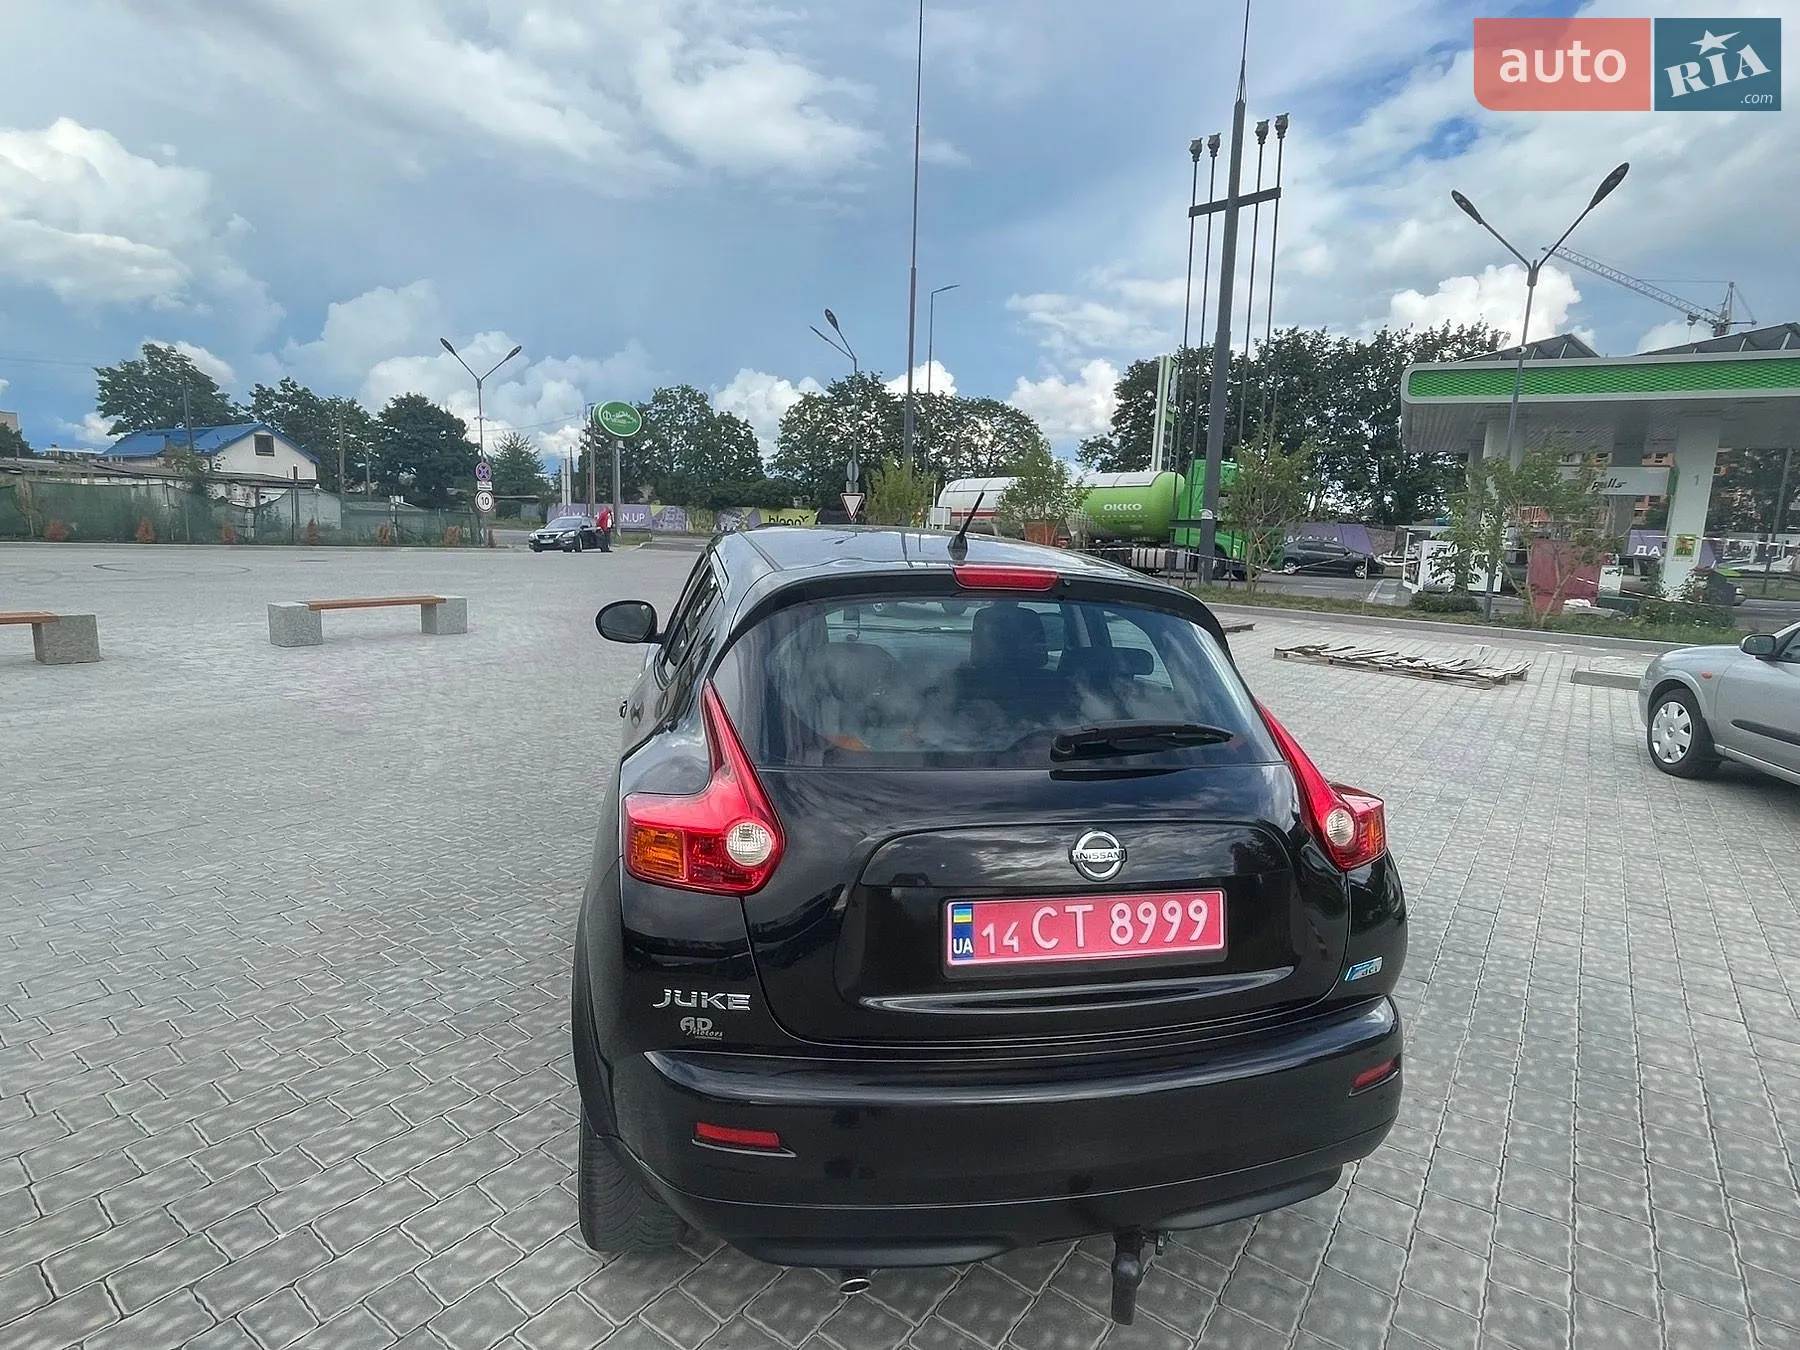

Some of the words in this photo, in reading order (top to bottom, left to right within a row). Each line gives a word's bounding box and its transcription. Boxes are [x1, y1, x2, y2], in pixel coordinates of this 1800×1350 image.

[481, 496, 490, 506] 10
[1103, 503, 1143, 511] OKKO
[1079, 851, 1125, 861] NISSAN
[980, 920, 1020, 954] 14
[1031, 903, 1094, 949] CT
[1110, 898, 1209, 946] 8999
[953, 936, 974, 954] UA
[652, 988, 751, 1011] JUKE
